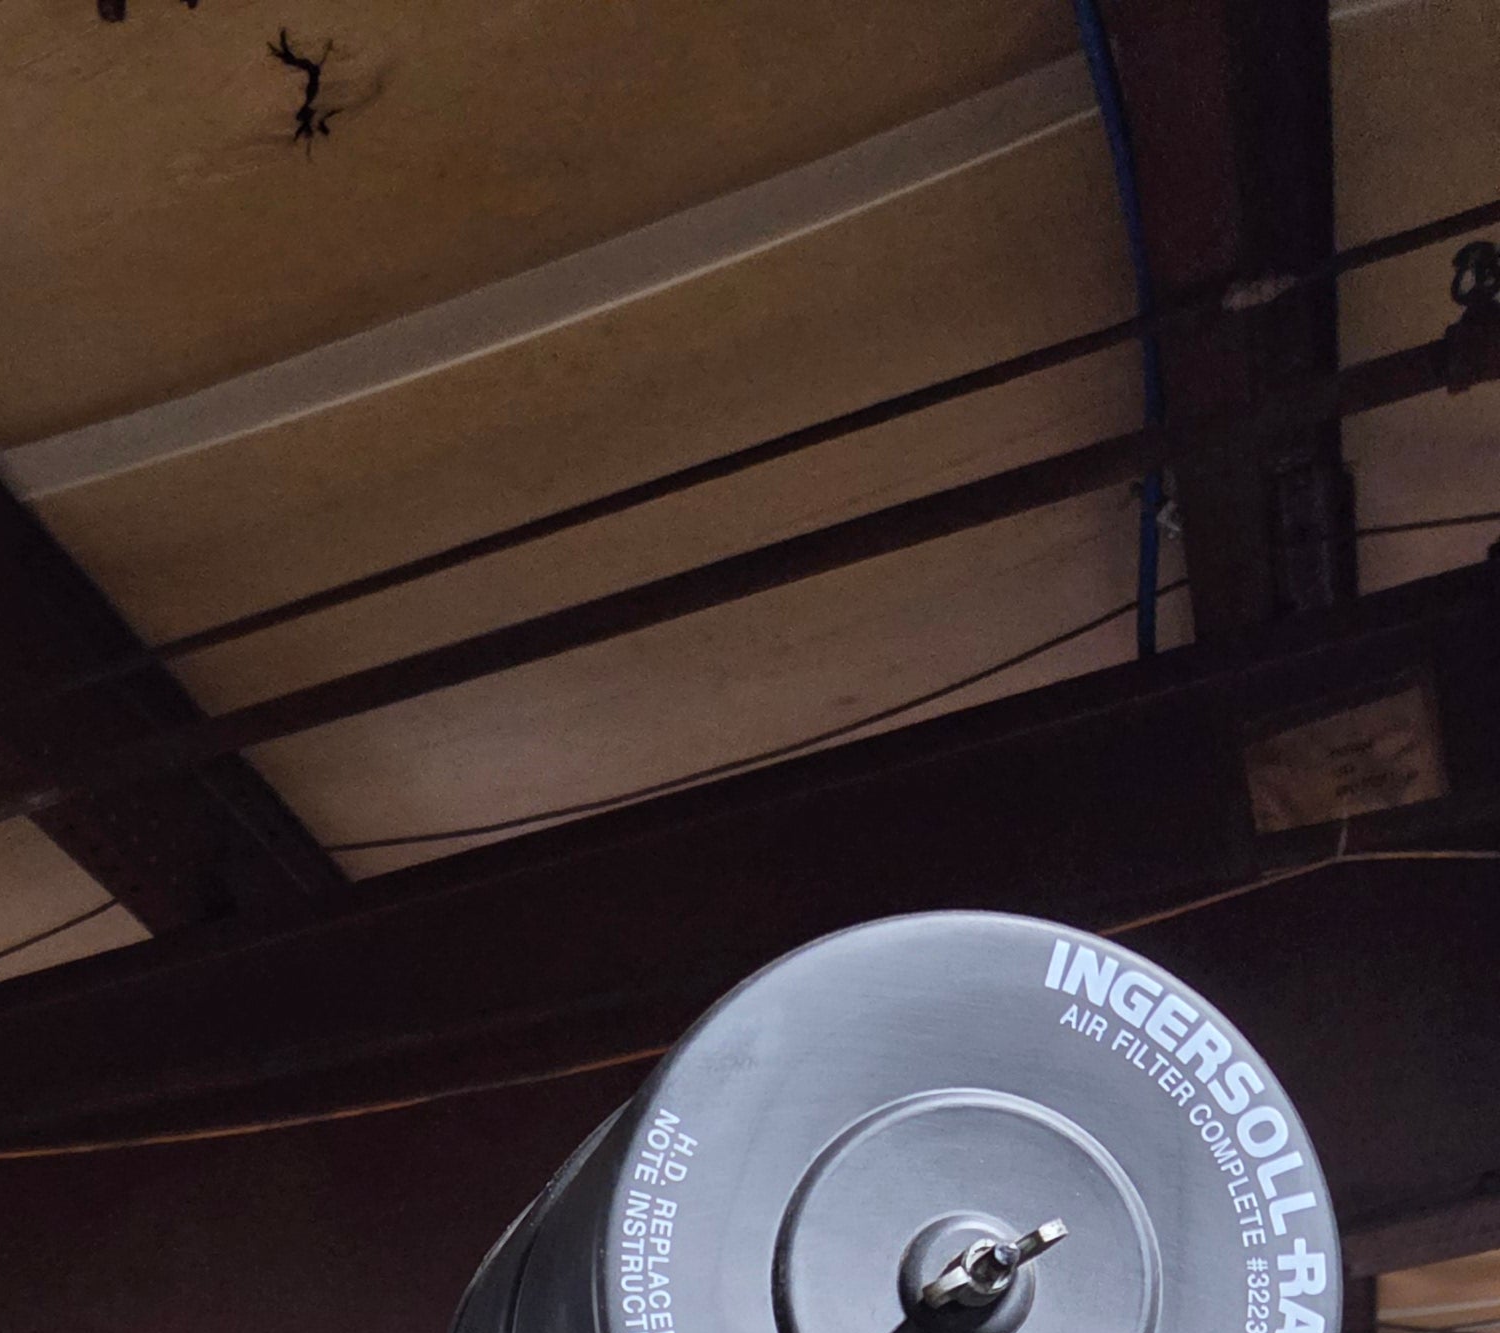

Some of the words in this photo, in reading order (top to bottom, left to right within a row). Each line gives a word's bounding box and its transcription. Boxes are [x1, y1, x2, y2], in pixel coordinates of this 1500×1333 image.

[634, 1108, 680, 1184] NOTE
[660, 1134, 698, 1186] H.D.
[1059, 1004, 1109, 1042] AIR
[1111, 1029, 1195, 1107] FILTER
[1189, 1104, 1266, 1248] COMPLETE
